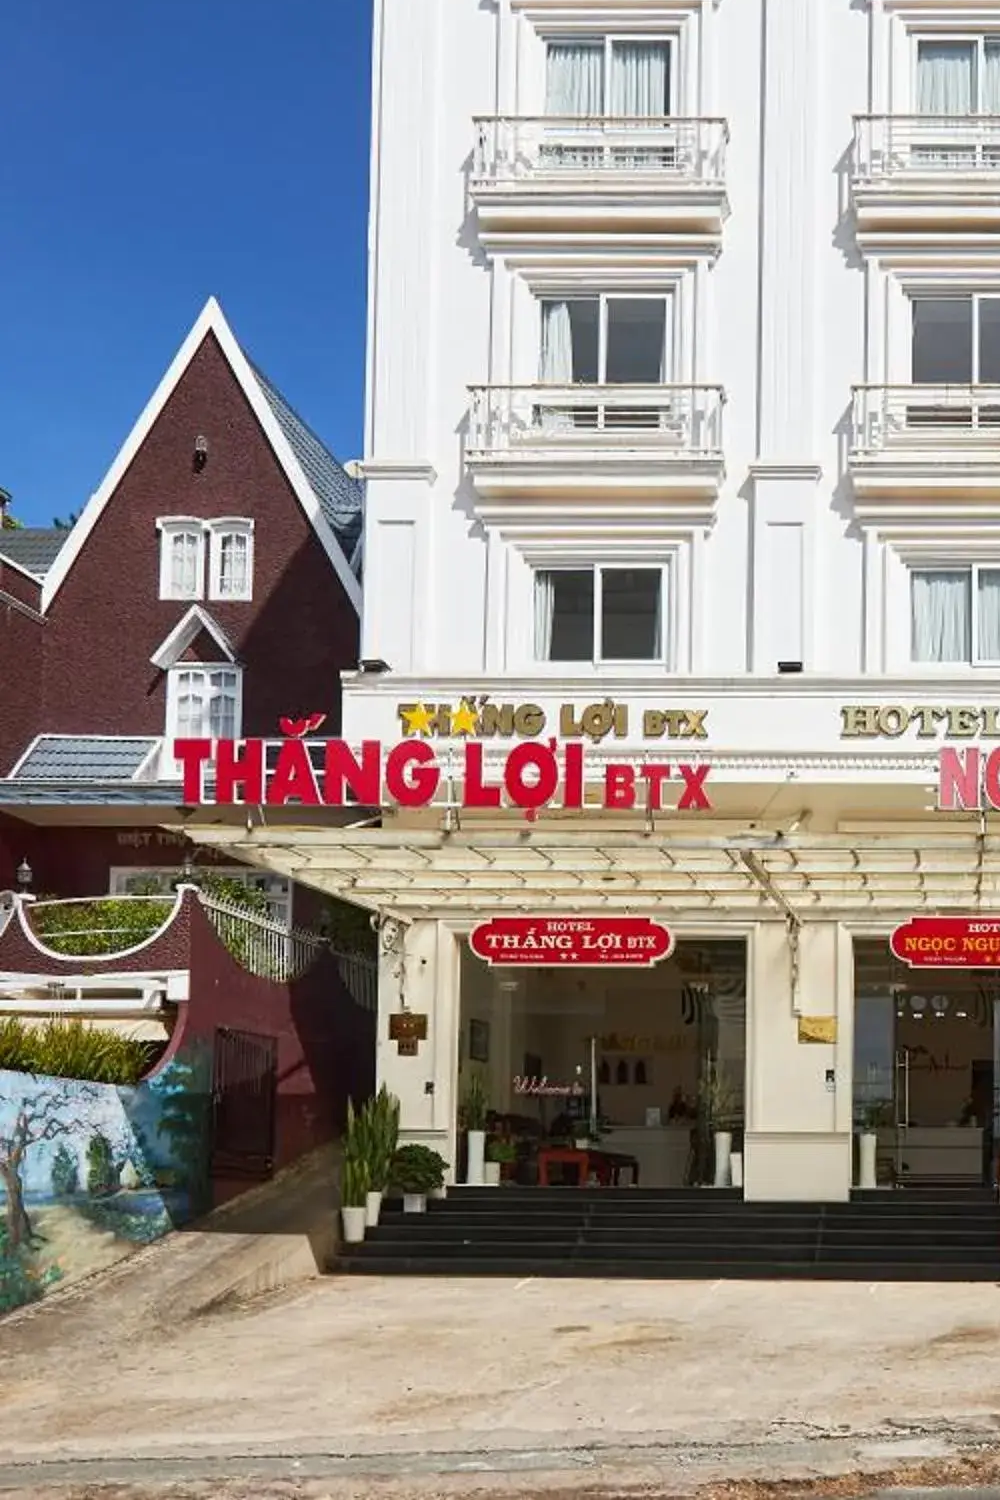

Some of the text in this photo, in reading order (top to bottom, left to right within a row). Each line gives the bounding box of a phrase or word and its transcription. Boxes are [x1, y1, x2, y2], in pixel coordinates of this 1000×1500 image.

[560, 697, 628, 744] LỢI
[643, 710, 708, 738] BTX
[173, 712, 712, 822] THẮNG LỢI BTX
[547, 921, 595, 932] HOTEL
[485, 927, 573, 949] THẮNG
[582, 933, 622, 953] LỢI
[905, 937, 956, 955] NGỌC
